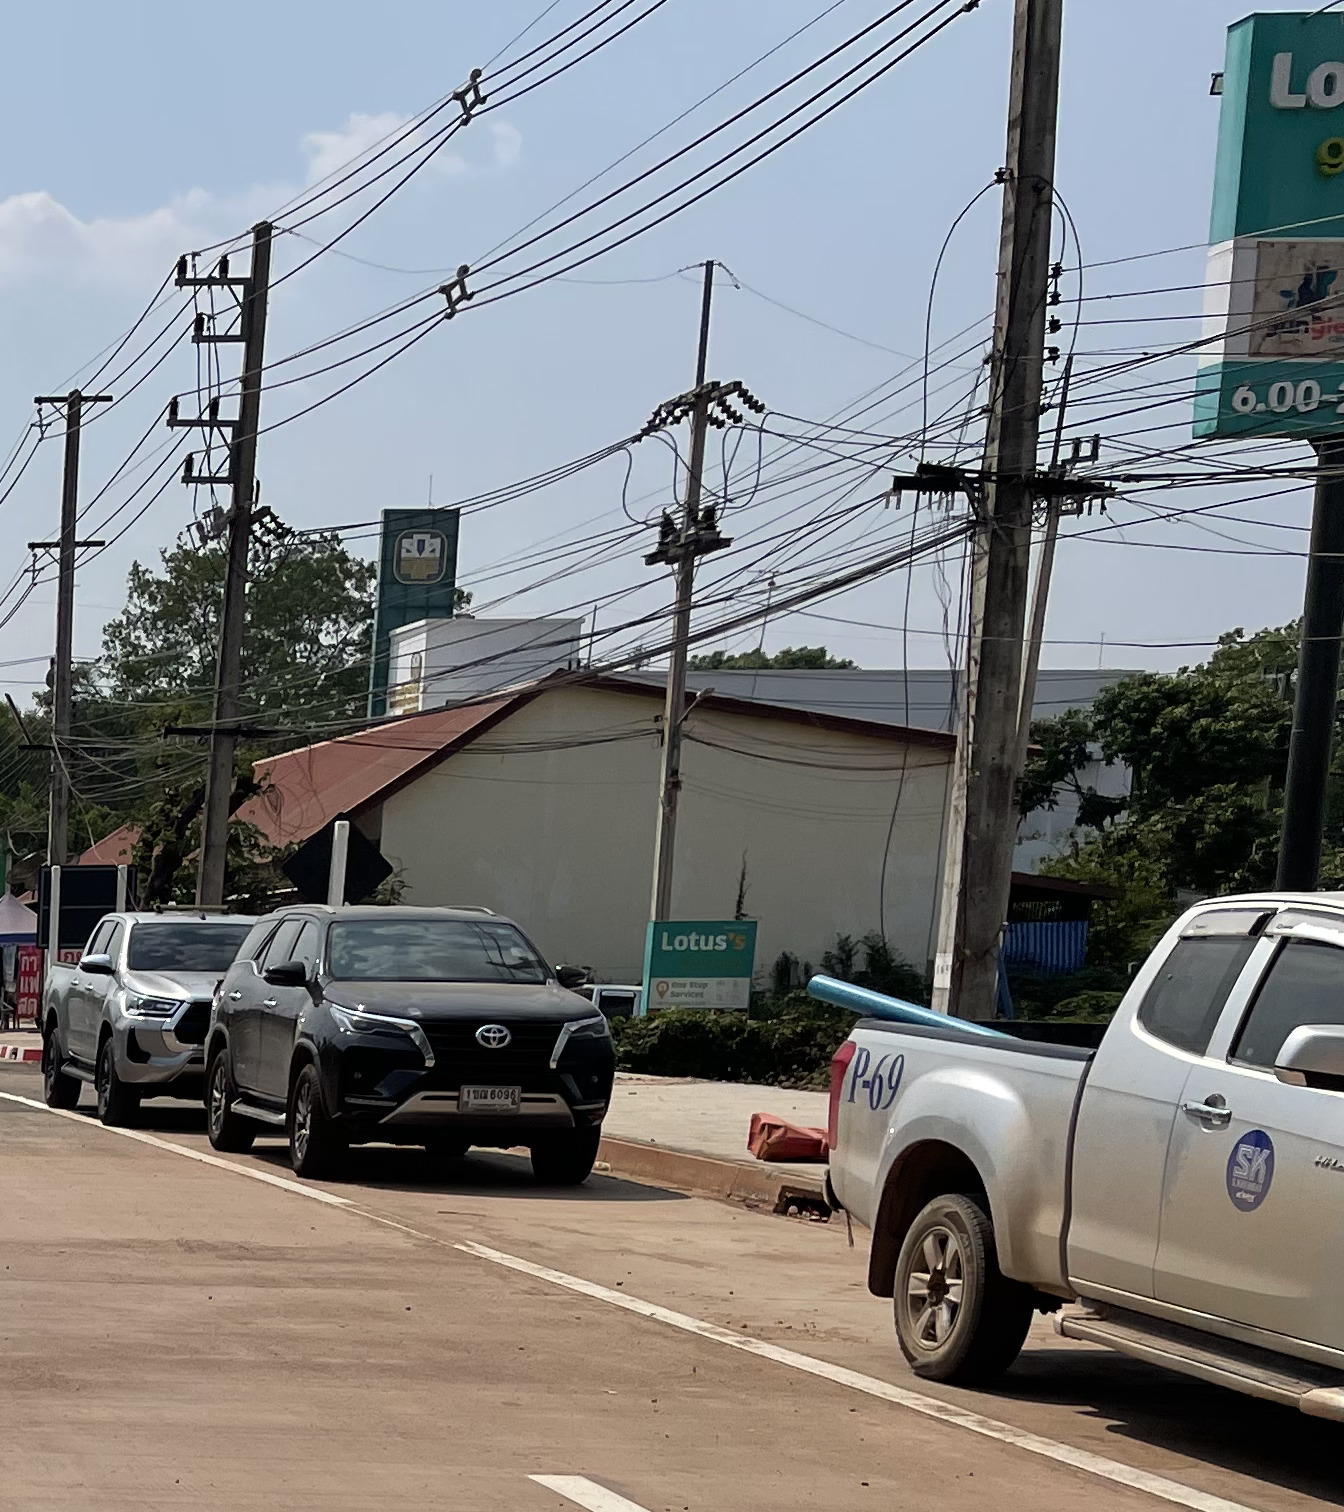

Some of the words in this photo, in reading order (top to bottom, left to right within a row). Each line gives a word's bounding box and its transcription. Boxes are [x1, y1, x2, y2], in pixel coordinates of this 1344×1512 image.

[661, 931, 747, 951] Lotus's
[847, 1047, 905, 1111] P-69
[1232, 1143, 1271, 1185] SK
